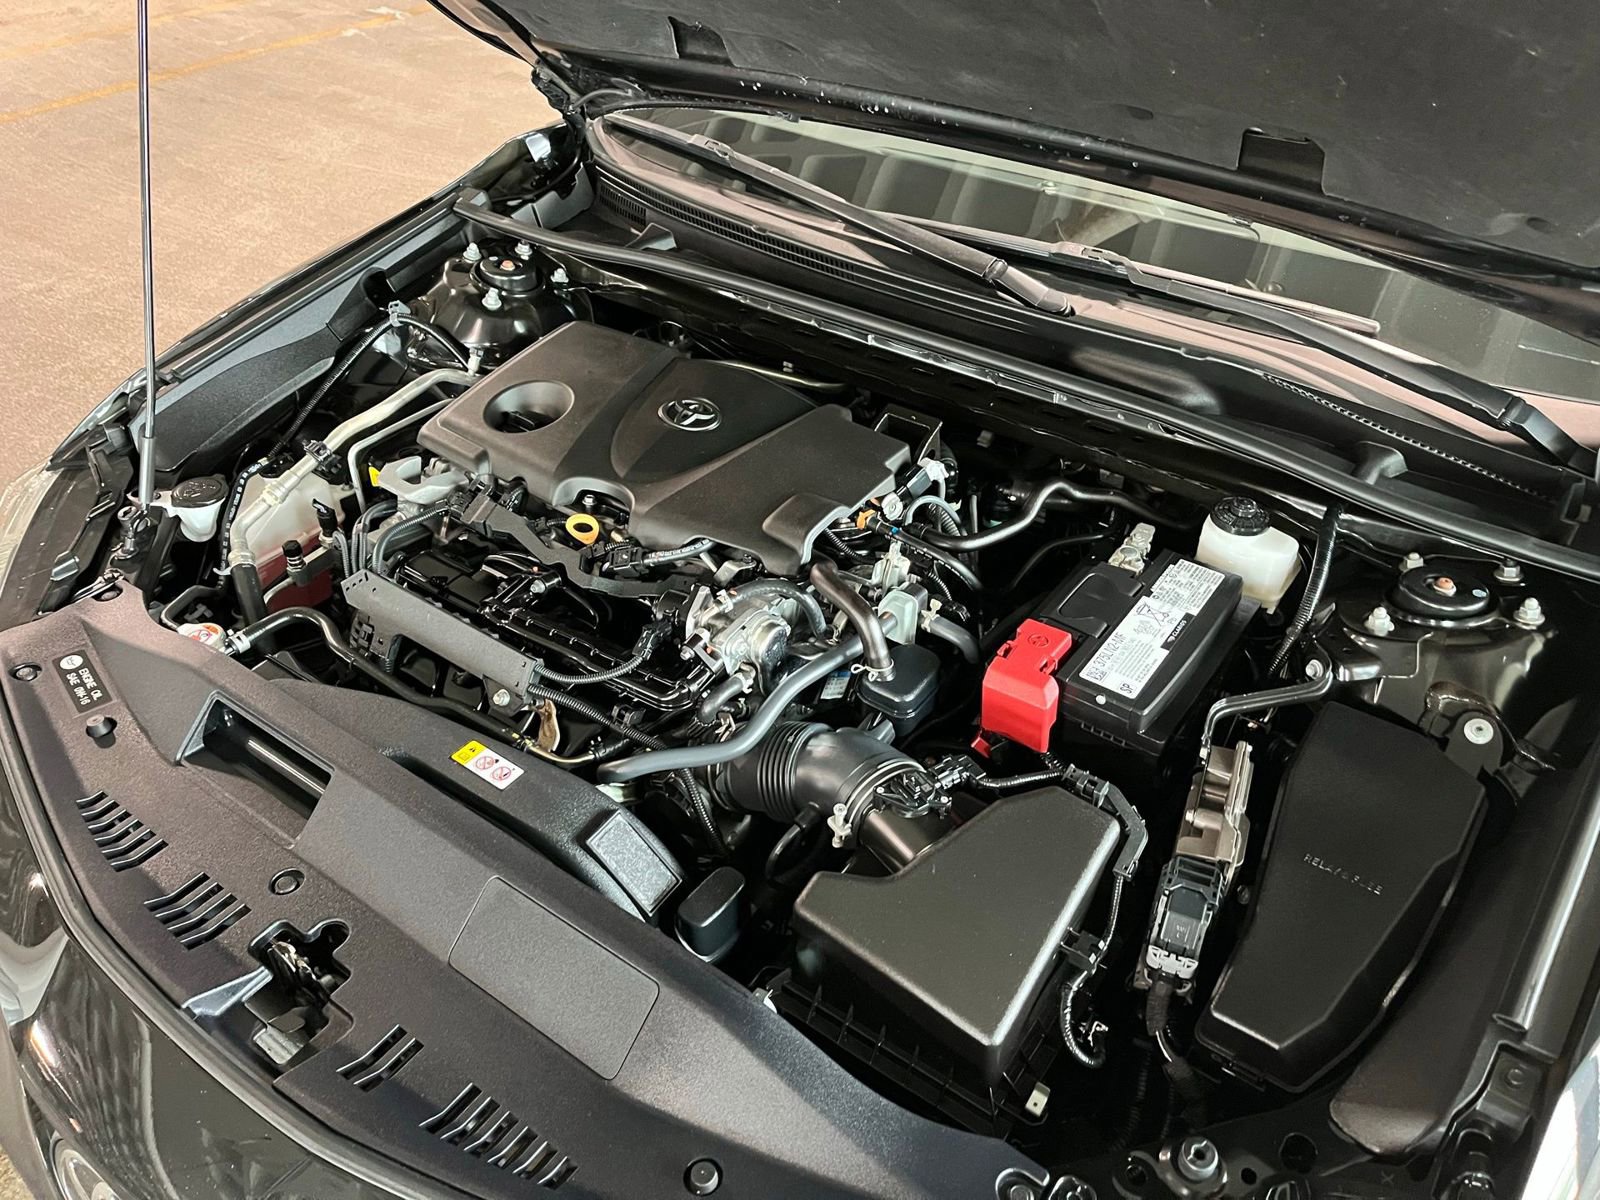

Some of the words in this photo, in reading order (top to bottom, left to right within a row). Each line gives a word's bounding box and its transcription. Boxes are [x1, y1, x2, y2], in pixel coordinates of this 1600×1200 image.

[66, 672, 80, 686] SAE
[78, 668, 97, 689] ENGINE
[90, 689, 103, 701] OIL
[1120, 683, 1133, 694] SP
